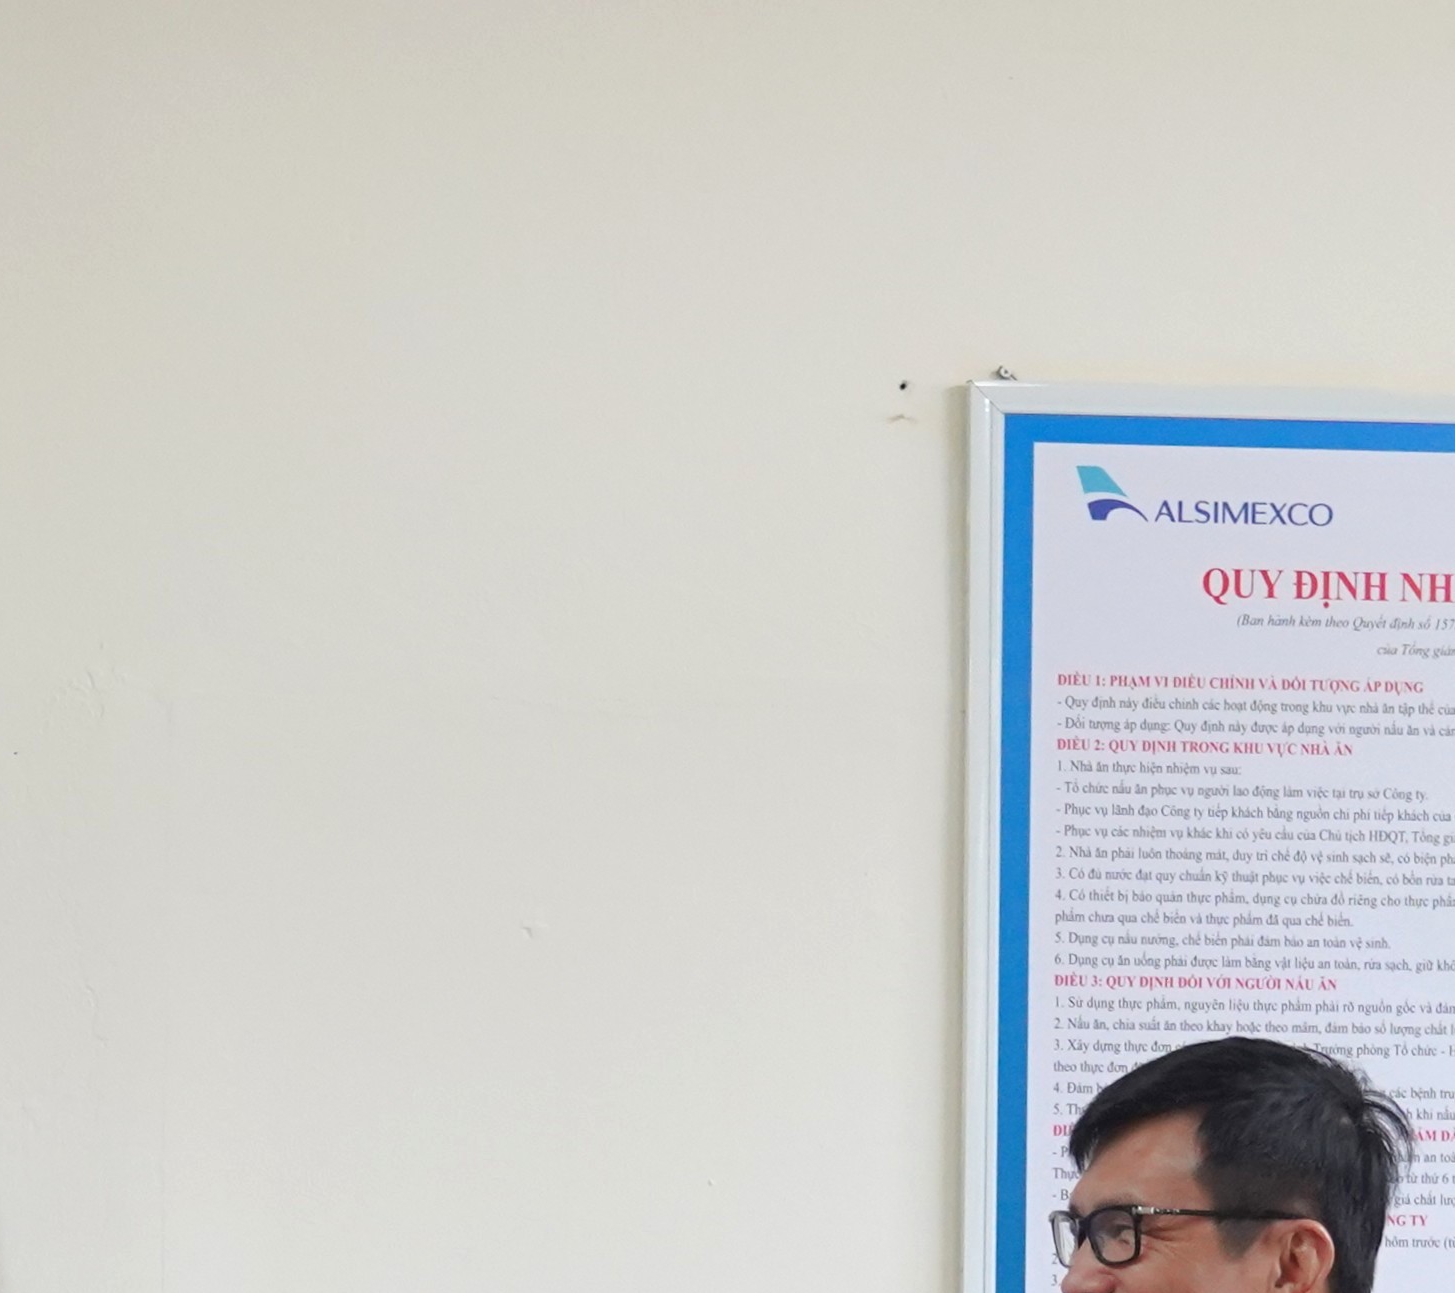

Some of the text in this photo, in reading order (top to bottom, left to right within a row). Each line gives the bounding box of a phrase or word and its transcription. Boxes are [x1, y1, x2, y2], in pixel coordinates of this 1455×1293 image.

[1154, 500, 1333, 527] ALSIMEXCO
[1202, 568, 1284, 606] QUY
[1293, 570, 1388, 609] ĐỊNH
[1236, 613, 1265, 628] (Ban
[1266, 614, 1297, 627] hành
[1298, 615, 1323, 628] kèm
[1324, 615, 1350, 629] theo
[1388, 617, 1416, 631] định
[1096, 676, 1106, 688] 1:
[1110, 676, 1150, 690] PHẠM
[1155, 676, 1168, 688] VI
[1385, 681, 1423, 696] DỤNG
[1094, 739, 1104, 752] 2:
[1109, 739, 1136, 753] QUY
[1181, 740, 1229, 754] TRONG
[1234, 742, 1263, 754] KHU
